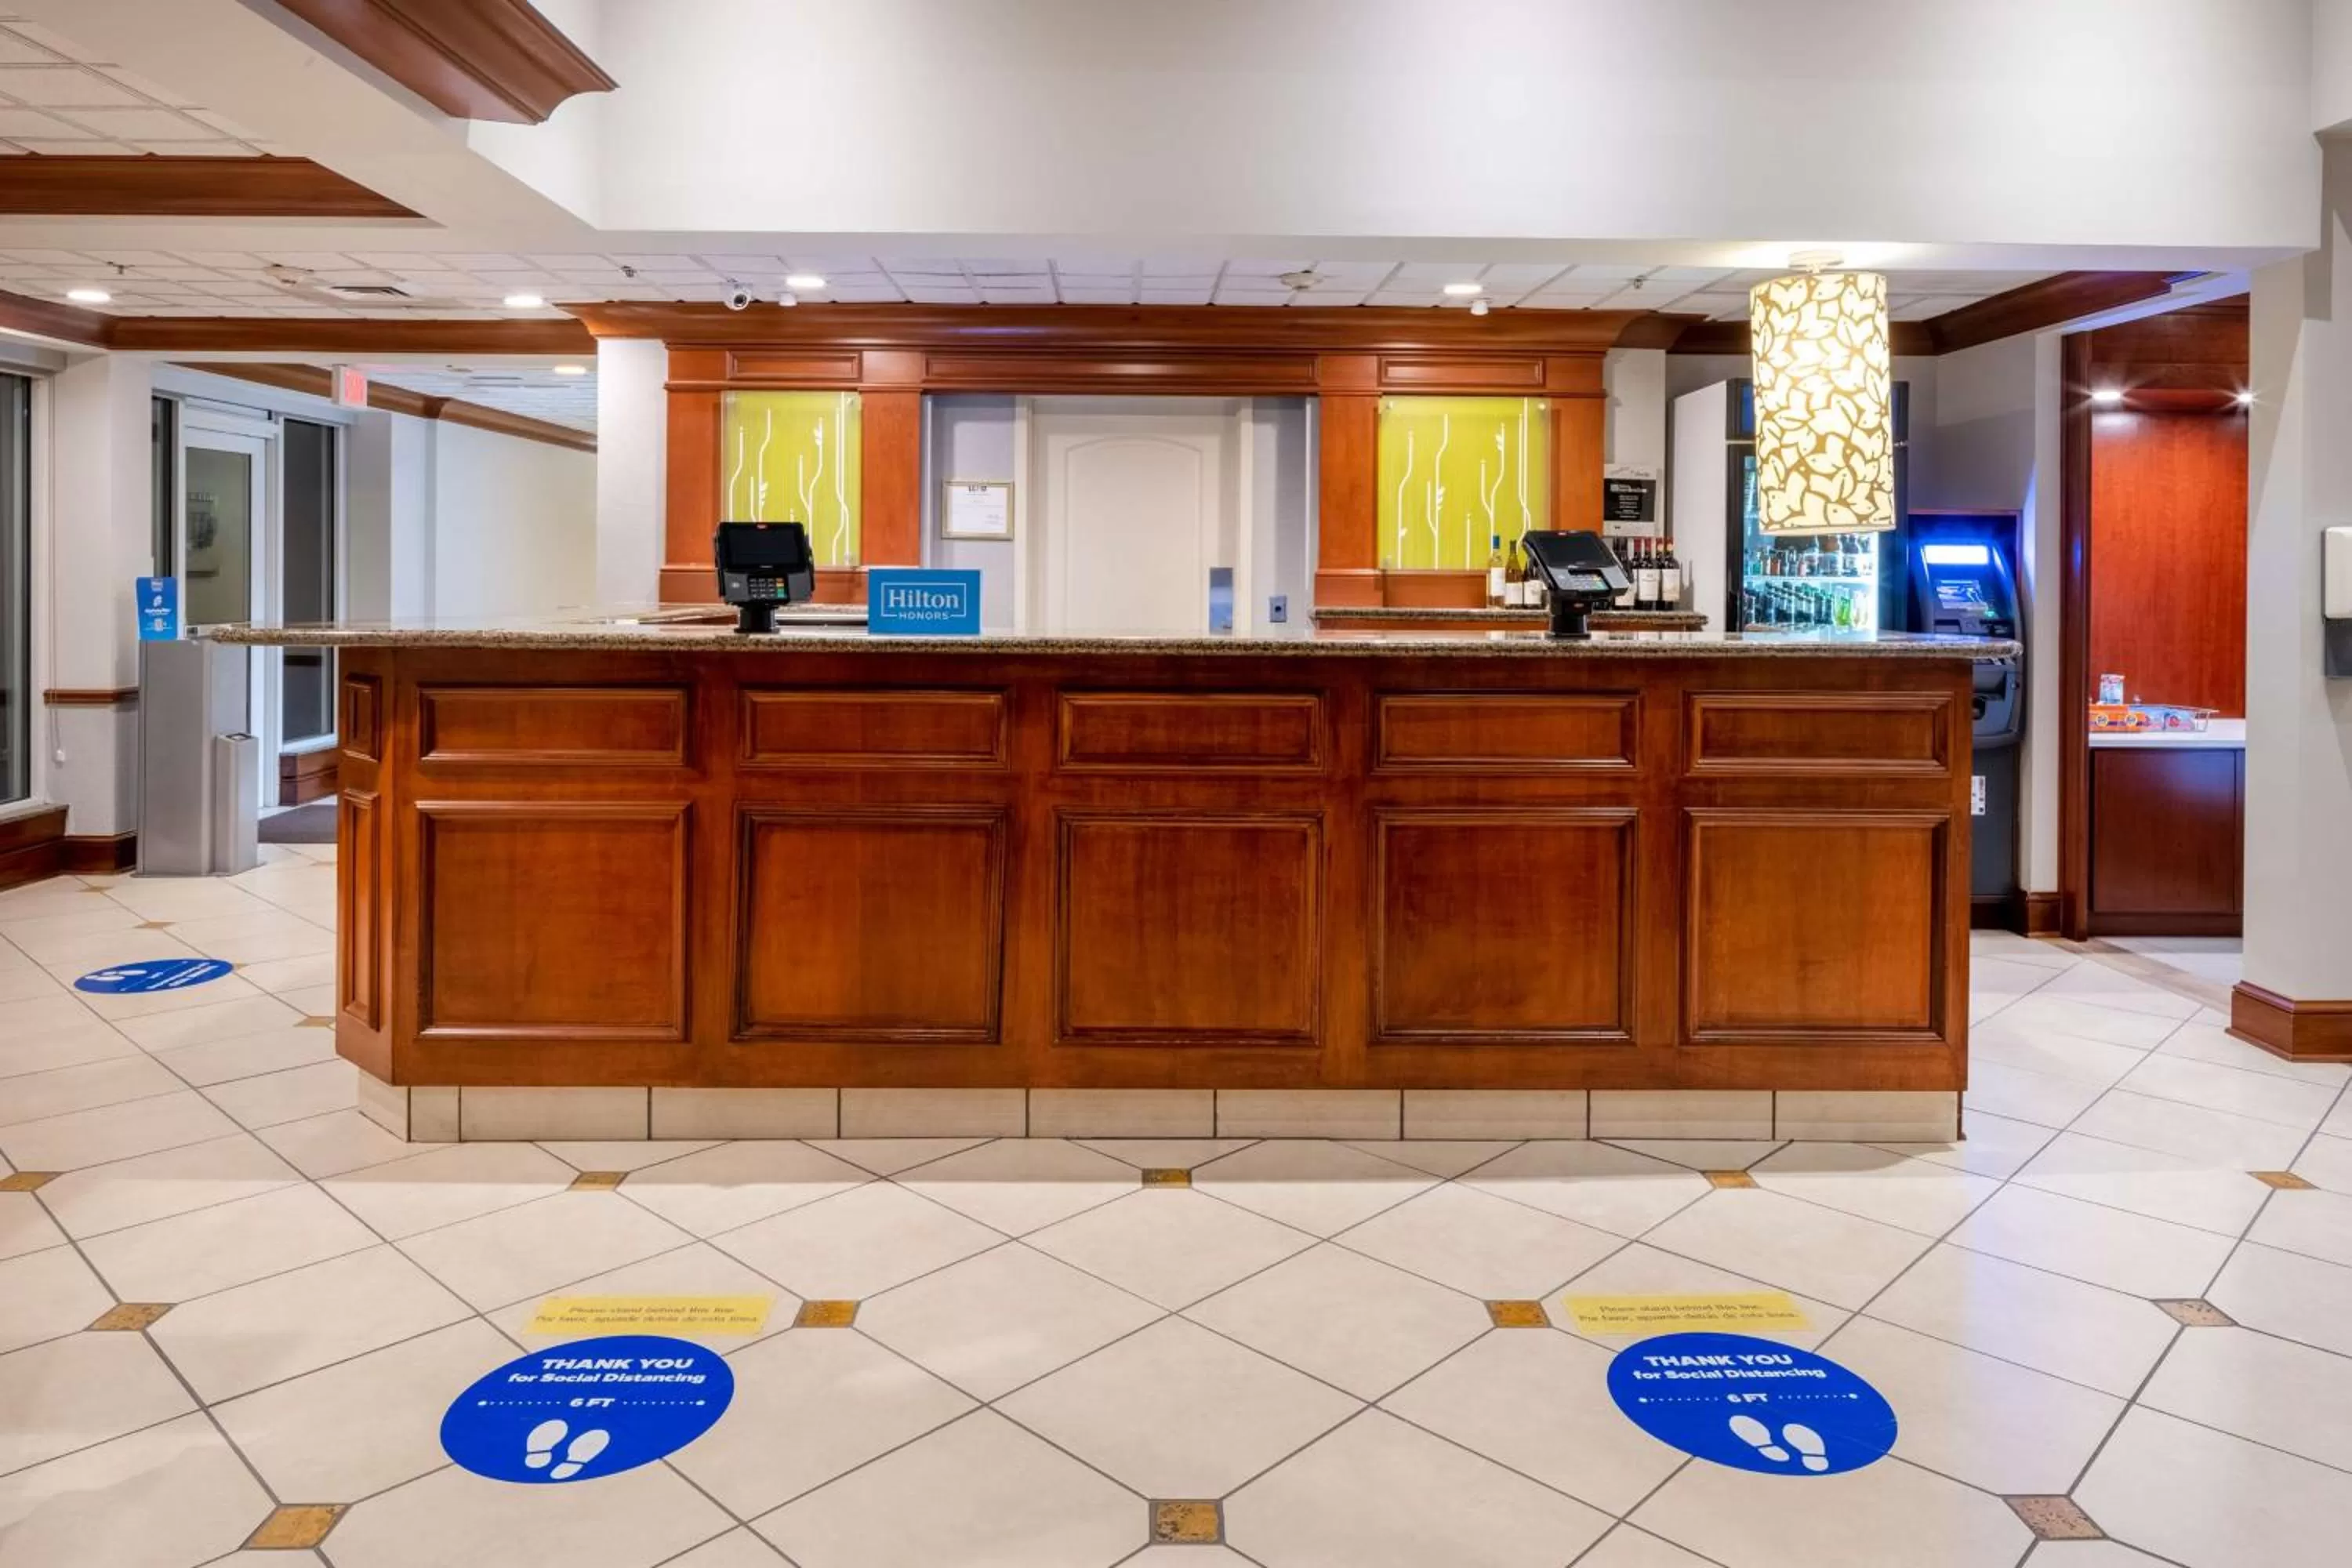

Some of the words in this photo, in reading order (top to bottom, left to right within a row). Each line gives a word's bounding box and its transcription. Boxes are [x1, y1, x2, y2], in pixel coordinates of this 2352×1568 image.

[887, 589, 959, 608] Hilton
[898, 611, 949, 620] HONORS
[542, 1359, 634, 1370] THANK
[639, 1359, 694, 1370] YOU
[1642, 1355, 1737, 1367] THANK
[1737, 1354, 1793, 1366] YOU
[508, 1373, 538, 1382] for
[539, 1373, 599, 1382] Social
[601, 1373, 707, 1384] Distancing
[1633, 1370, 1661, 1380] for
[1664, 1370, 1724, 1380] Social
[1724, 1368, 1828, 1379] Distancing
[569, 1398, 583, 1407] 6
[586, 1398, 616, 1407] FT
[1726, 1393, 1741, 1403] 6
[1742, 1393, 1769, 1403] FT
